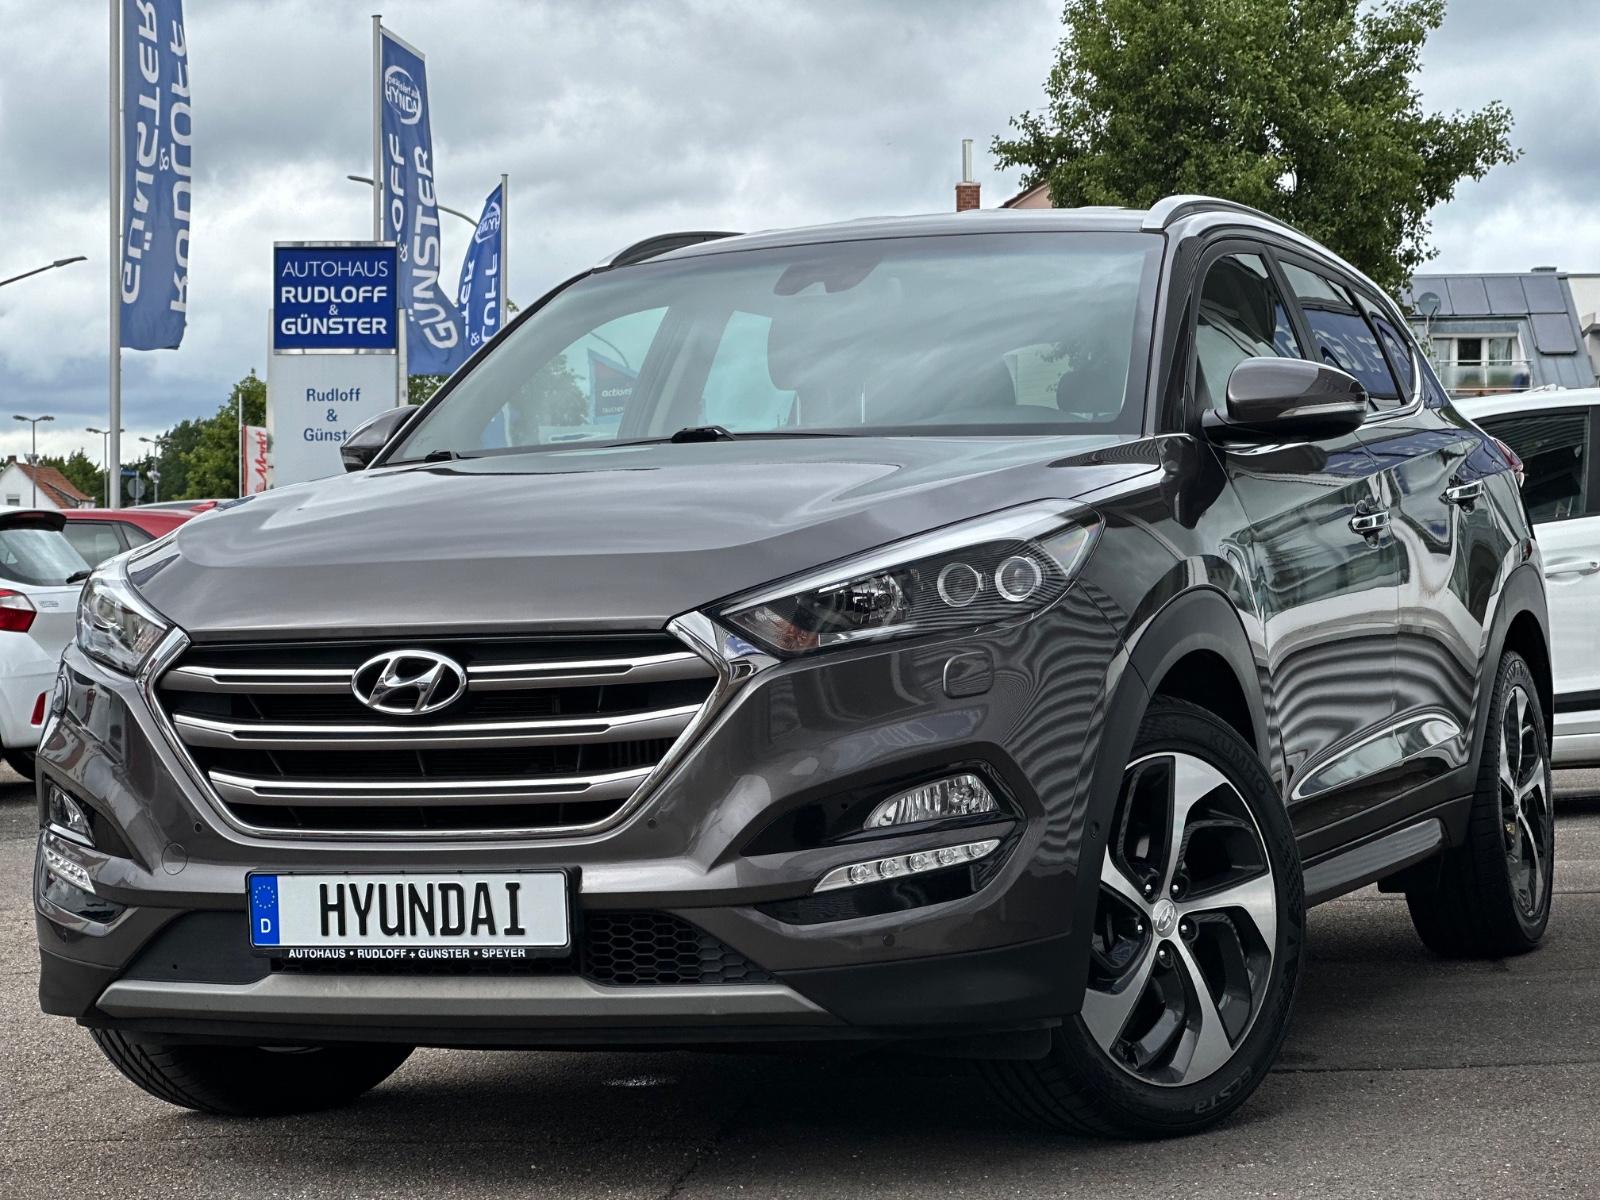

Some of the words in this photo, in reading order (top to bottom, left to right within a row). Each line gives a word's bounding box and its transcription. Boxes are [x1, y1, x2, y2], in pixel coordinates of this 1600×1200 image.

[388, 133, 405, 242] OFF
[409, 145, 459, 349] GÜNSTER
[281, 260, 389, 278] AUTOHAUS
[280, 286, 388, 304] RUDLOFF
[328, 304, 339, 316] &
[280, 313, 388, 335] GÜNSTER
[306, 387, 361, 402] Rudloff
[326, 408, 338, 422] &
[303, 427, 351, 442] Günst
[318, 882, 526, 937] HYUNDAI
[260, 917, 272, 934] D
[288, 949, 346, 960] AUTOHAUS
[356, 949, 407, 960] RUDLOFF
[481, 948, 527, 959] SPEYER
